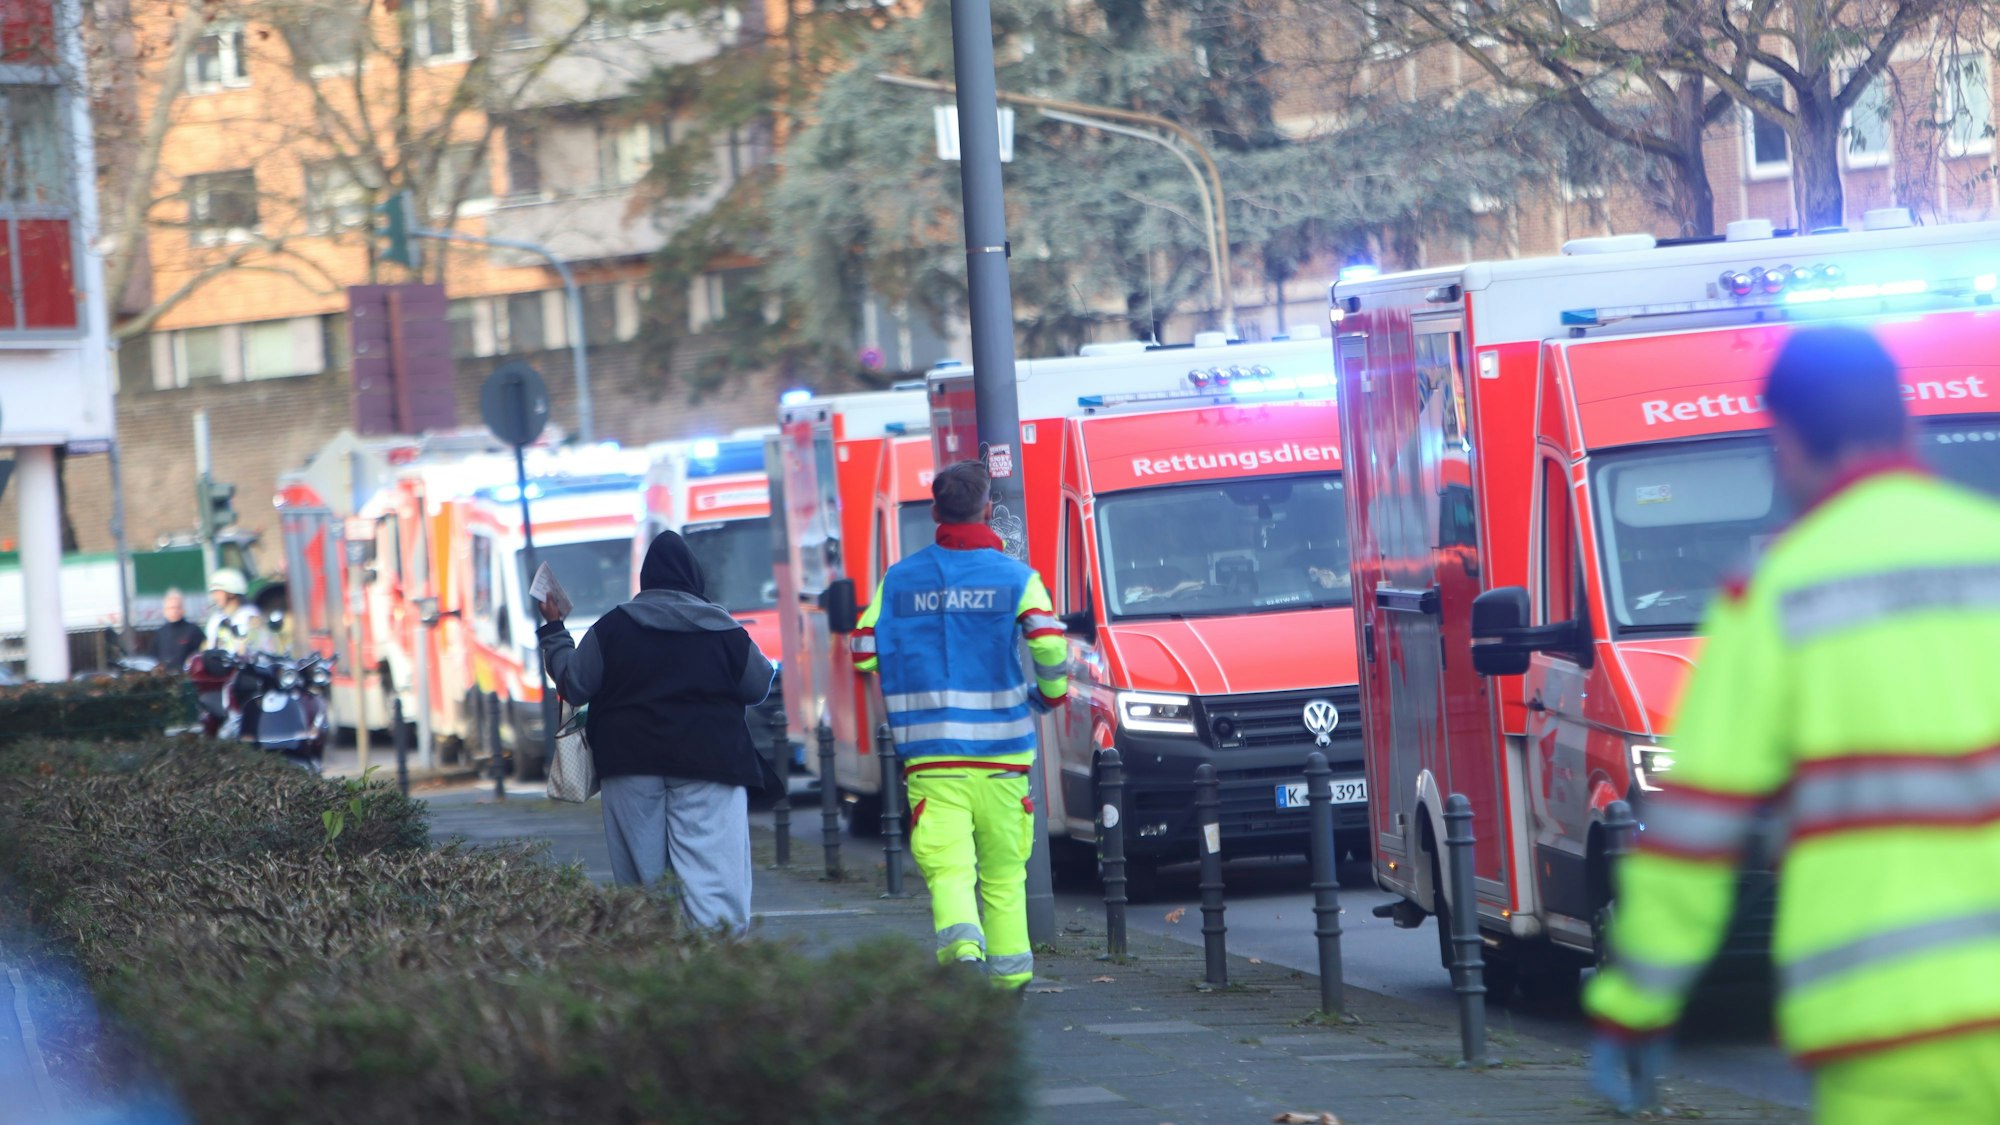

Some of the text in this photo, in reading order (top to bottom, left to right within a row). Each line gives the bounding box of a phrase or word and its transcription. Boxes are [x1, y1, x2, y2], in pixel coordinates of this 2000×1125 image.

[1641, 375, 1989, 426] Rettuenst
[1131, 443, 1341, 477] Rettungsdien
[914, 589, 997, 612] NOTARZT
[1288, 788, 1299, 805] K
[1336, 783, 1367, 801] 391
